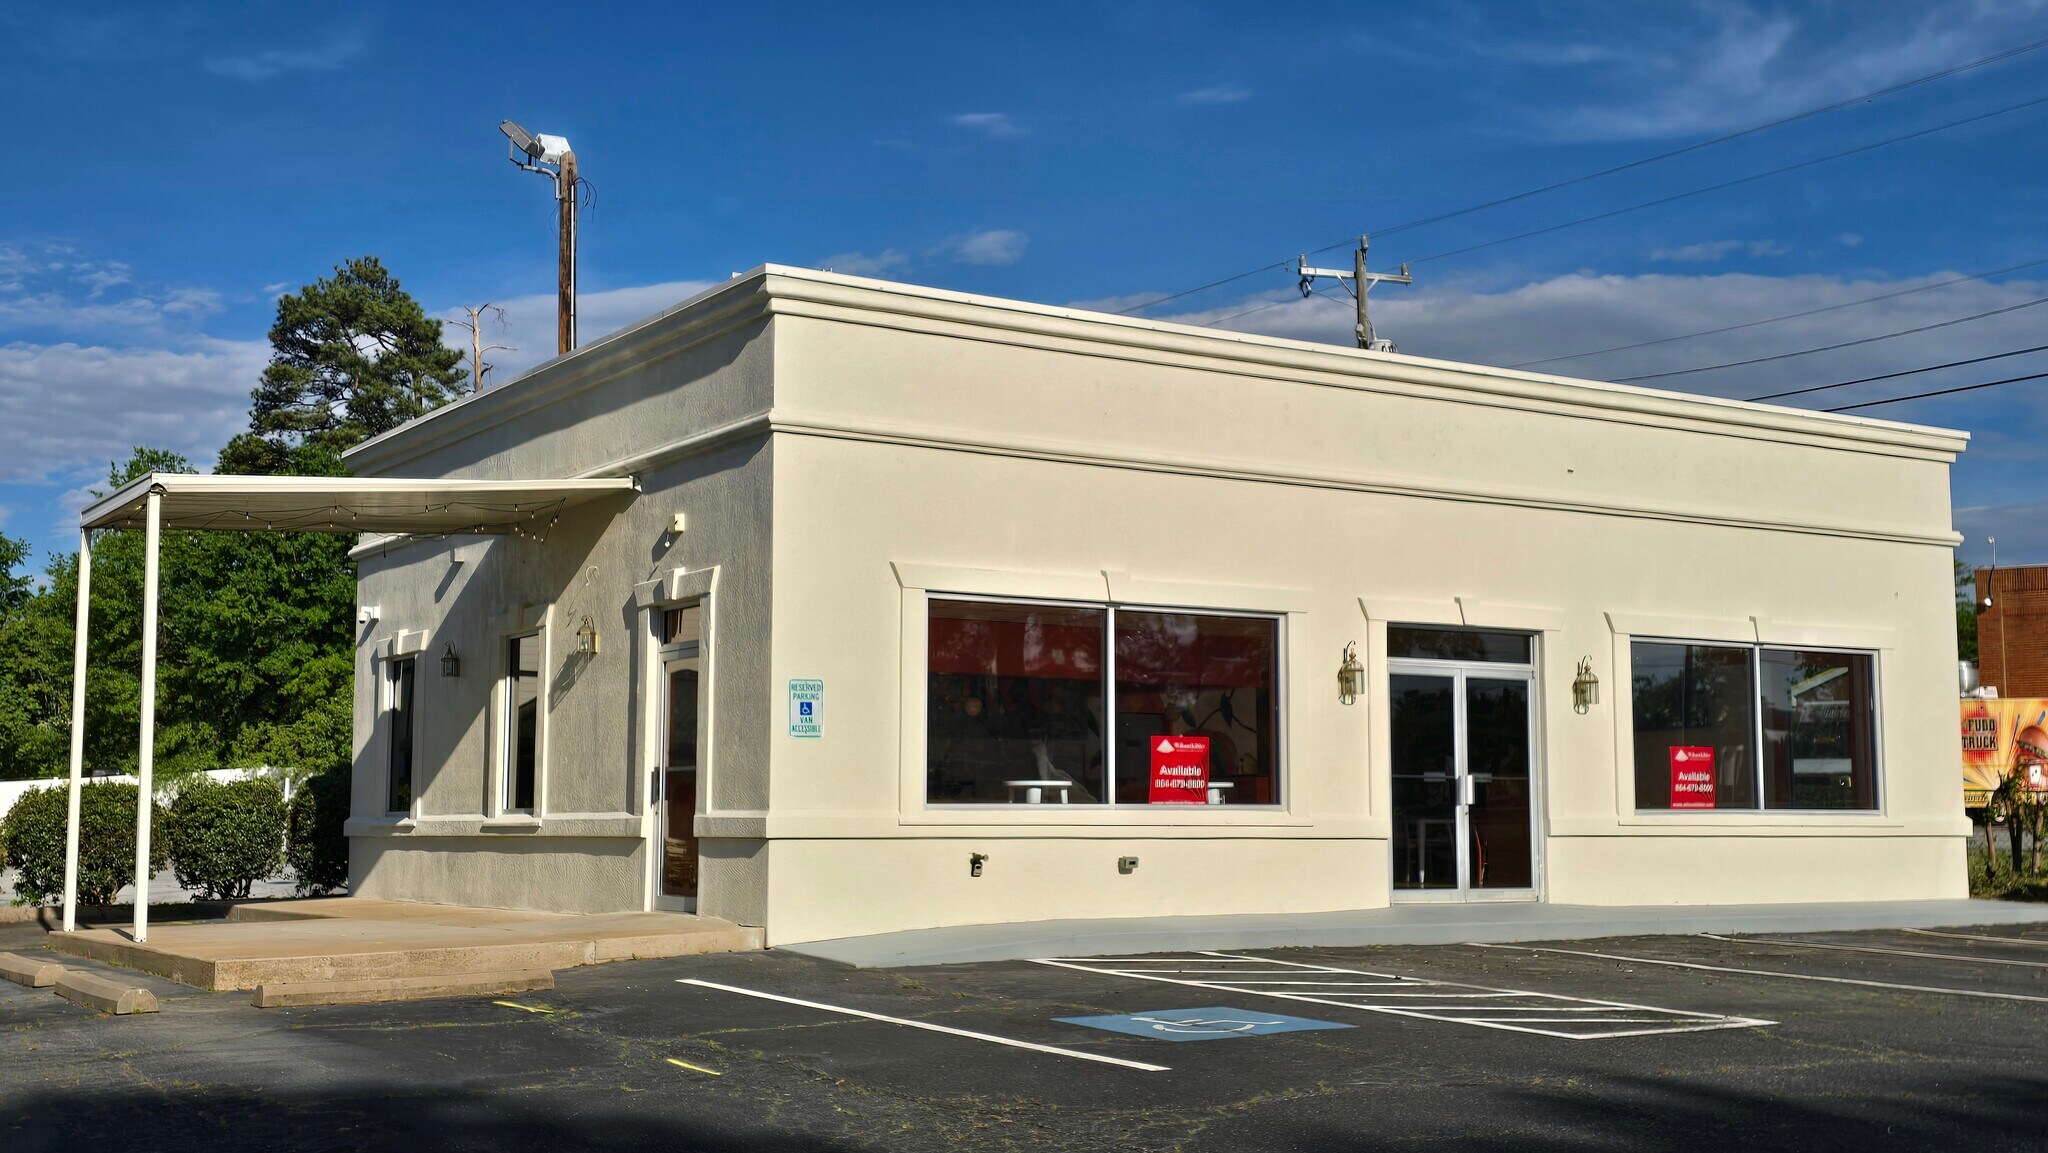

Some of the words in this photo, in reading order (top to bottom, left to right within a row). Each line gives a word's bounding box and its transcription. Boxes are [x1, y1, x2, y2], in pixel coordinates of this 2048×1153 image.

[1962, 736, 1996, 749] TRUCK
[1159, 765, 1202, 776] Available
[1678, 772, 1710, 781] Available
